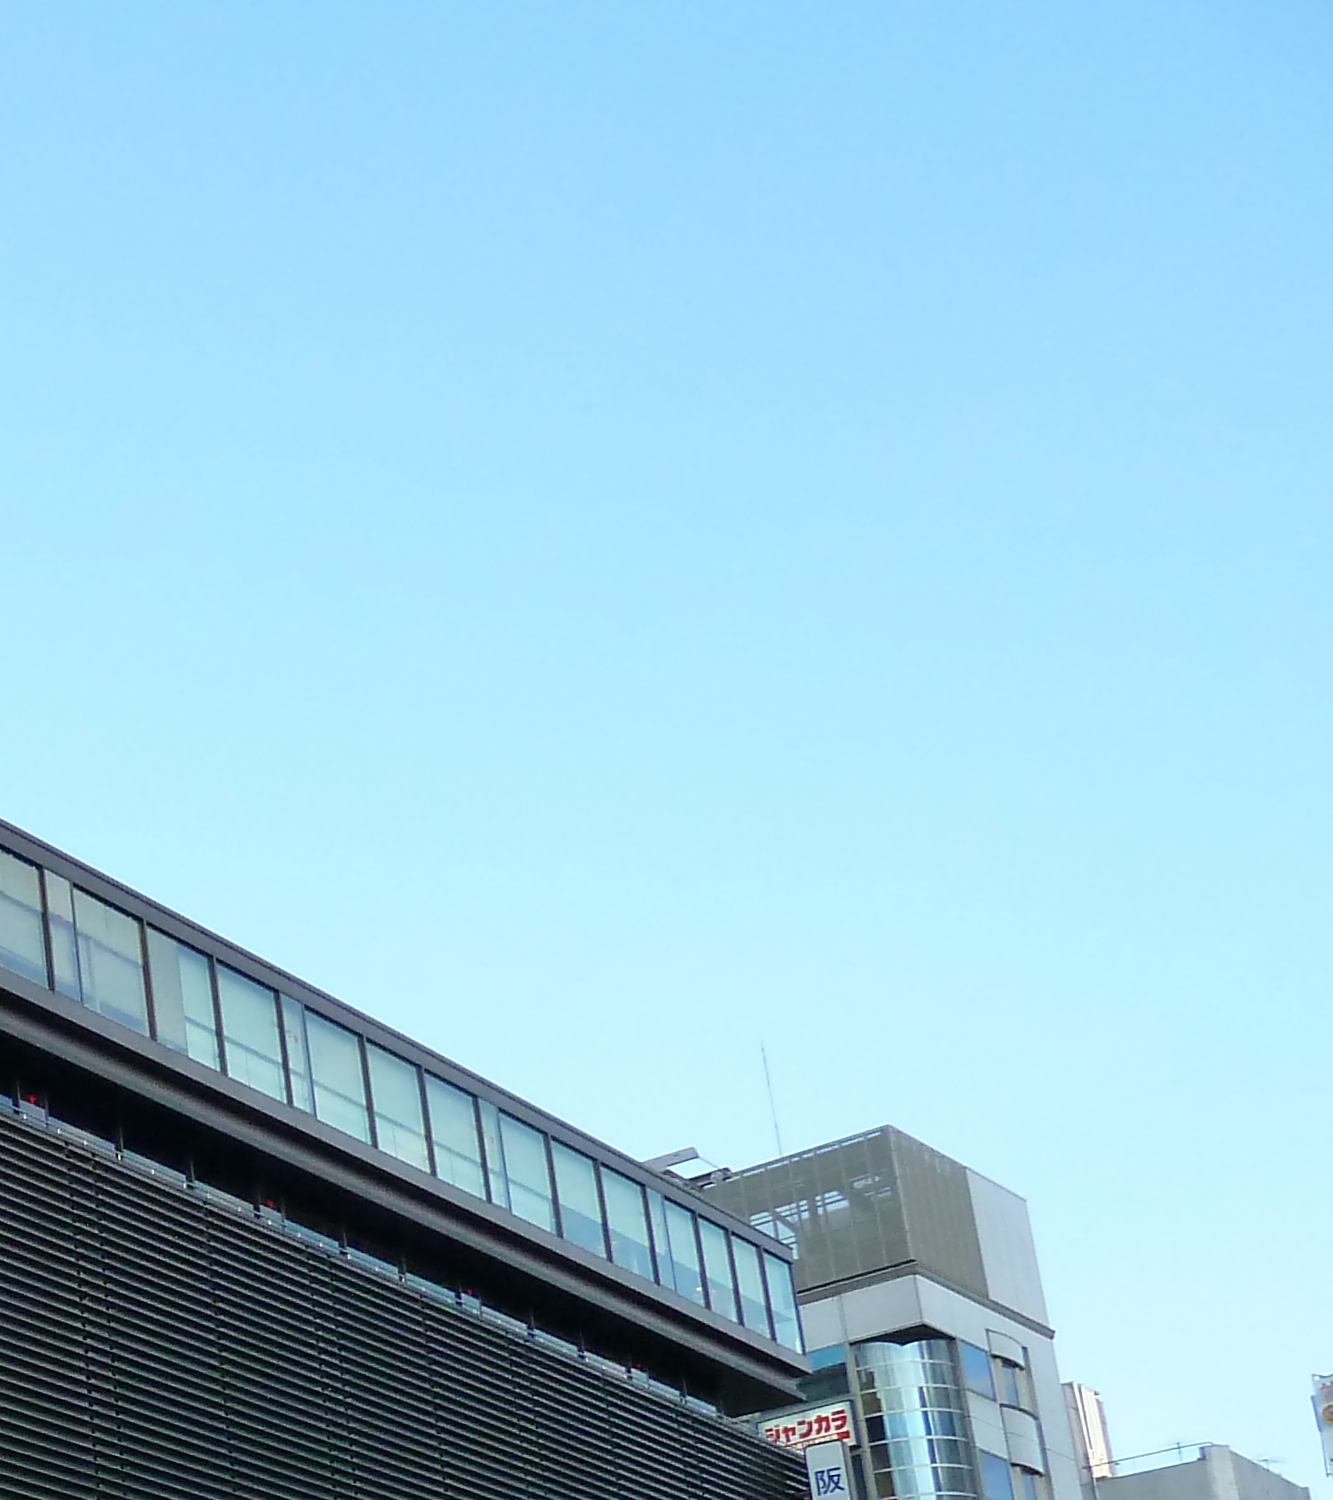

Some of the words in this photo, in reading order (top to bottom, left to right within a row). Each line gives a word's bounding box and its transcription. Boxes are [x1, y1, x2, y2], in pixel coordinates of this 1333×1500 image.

[764, 1408, 848, 1443] ジャンカラ
